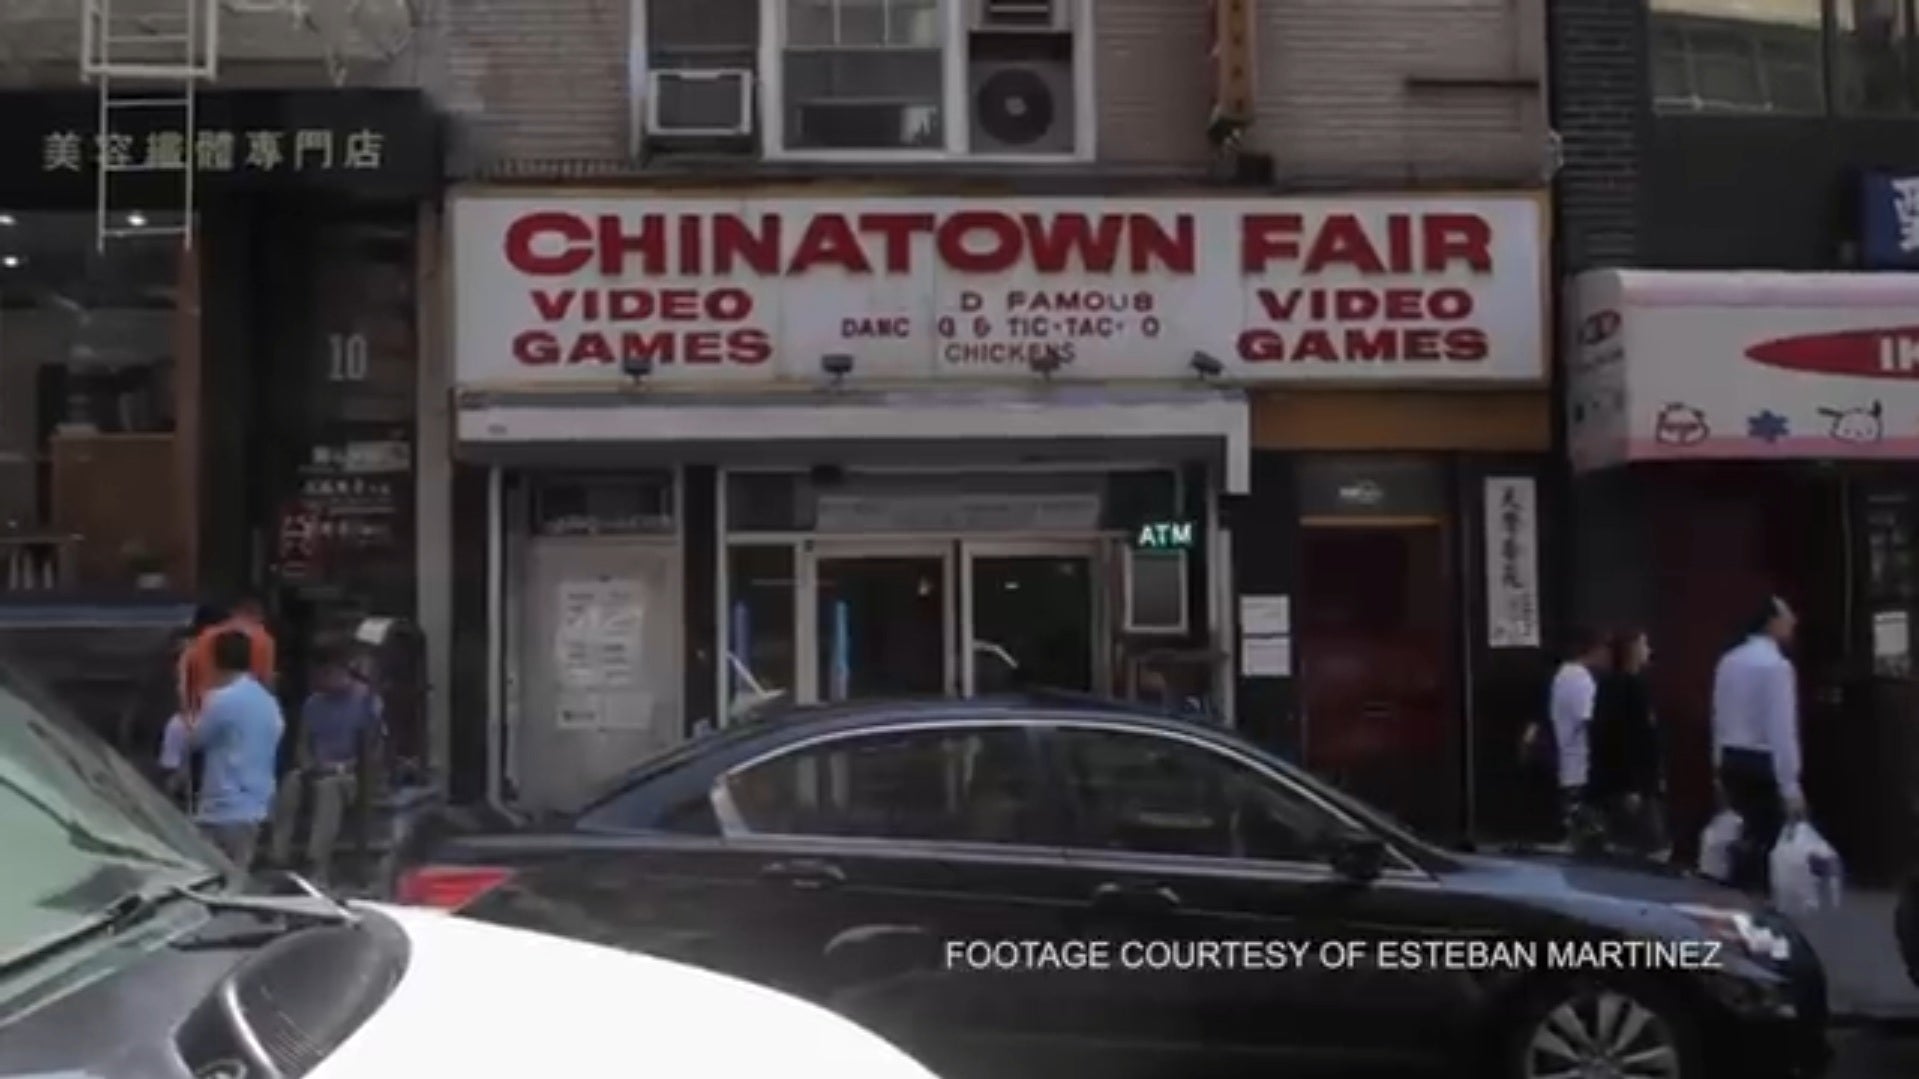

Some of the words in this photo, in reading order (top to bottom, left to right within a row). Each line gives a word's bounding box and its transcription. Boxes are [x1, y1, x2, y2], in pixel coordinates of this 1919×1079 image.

[505, 211, 1195, 276] CHINATOWN
[1241, 213, 1492, 274] FAIR
[530, 287, 754, 323] VIDEO
[1259, 288, 1473, 323] VIDEO
[329, 334, 368, 381] 10
[512, 330, 773, 366] GAMES
[1236, 327, 1489, 363] GAMES
[1137, 522, 1193, 548] ATM
